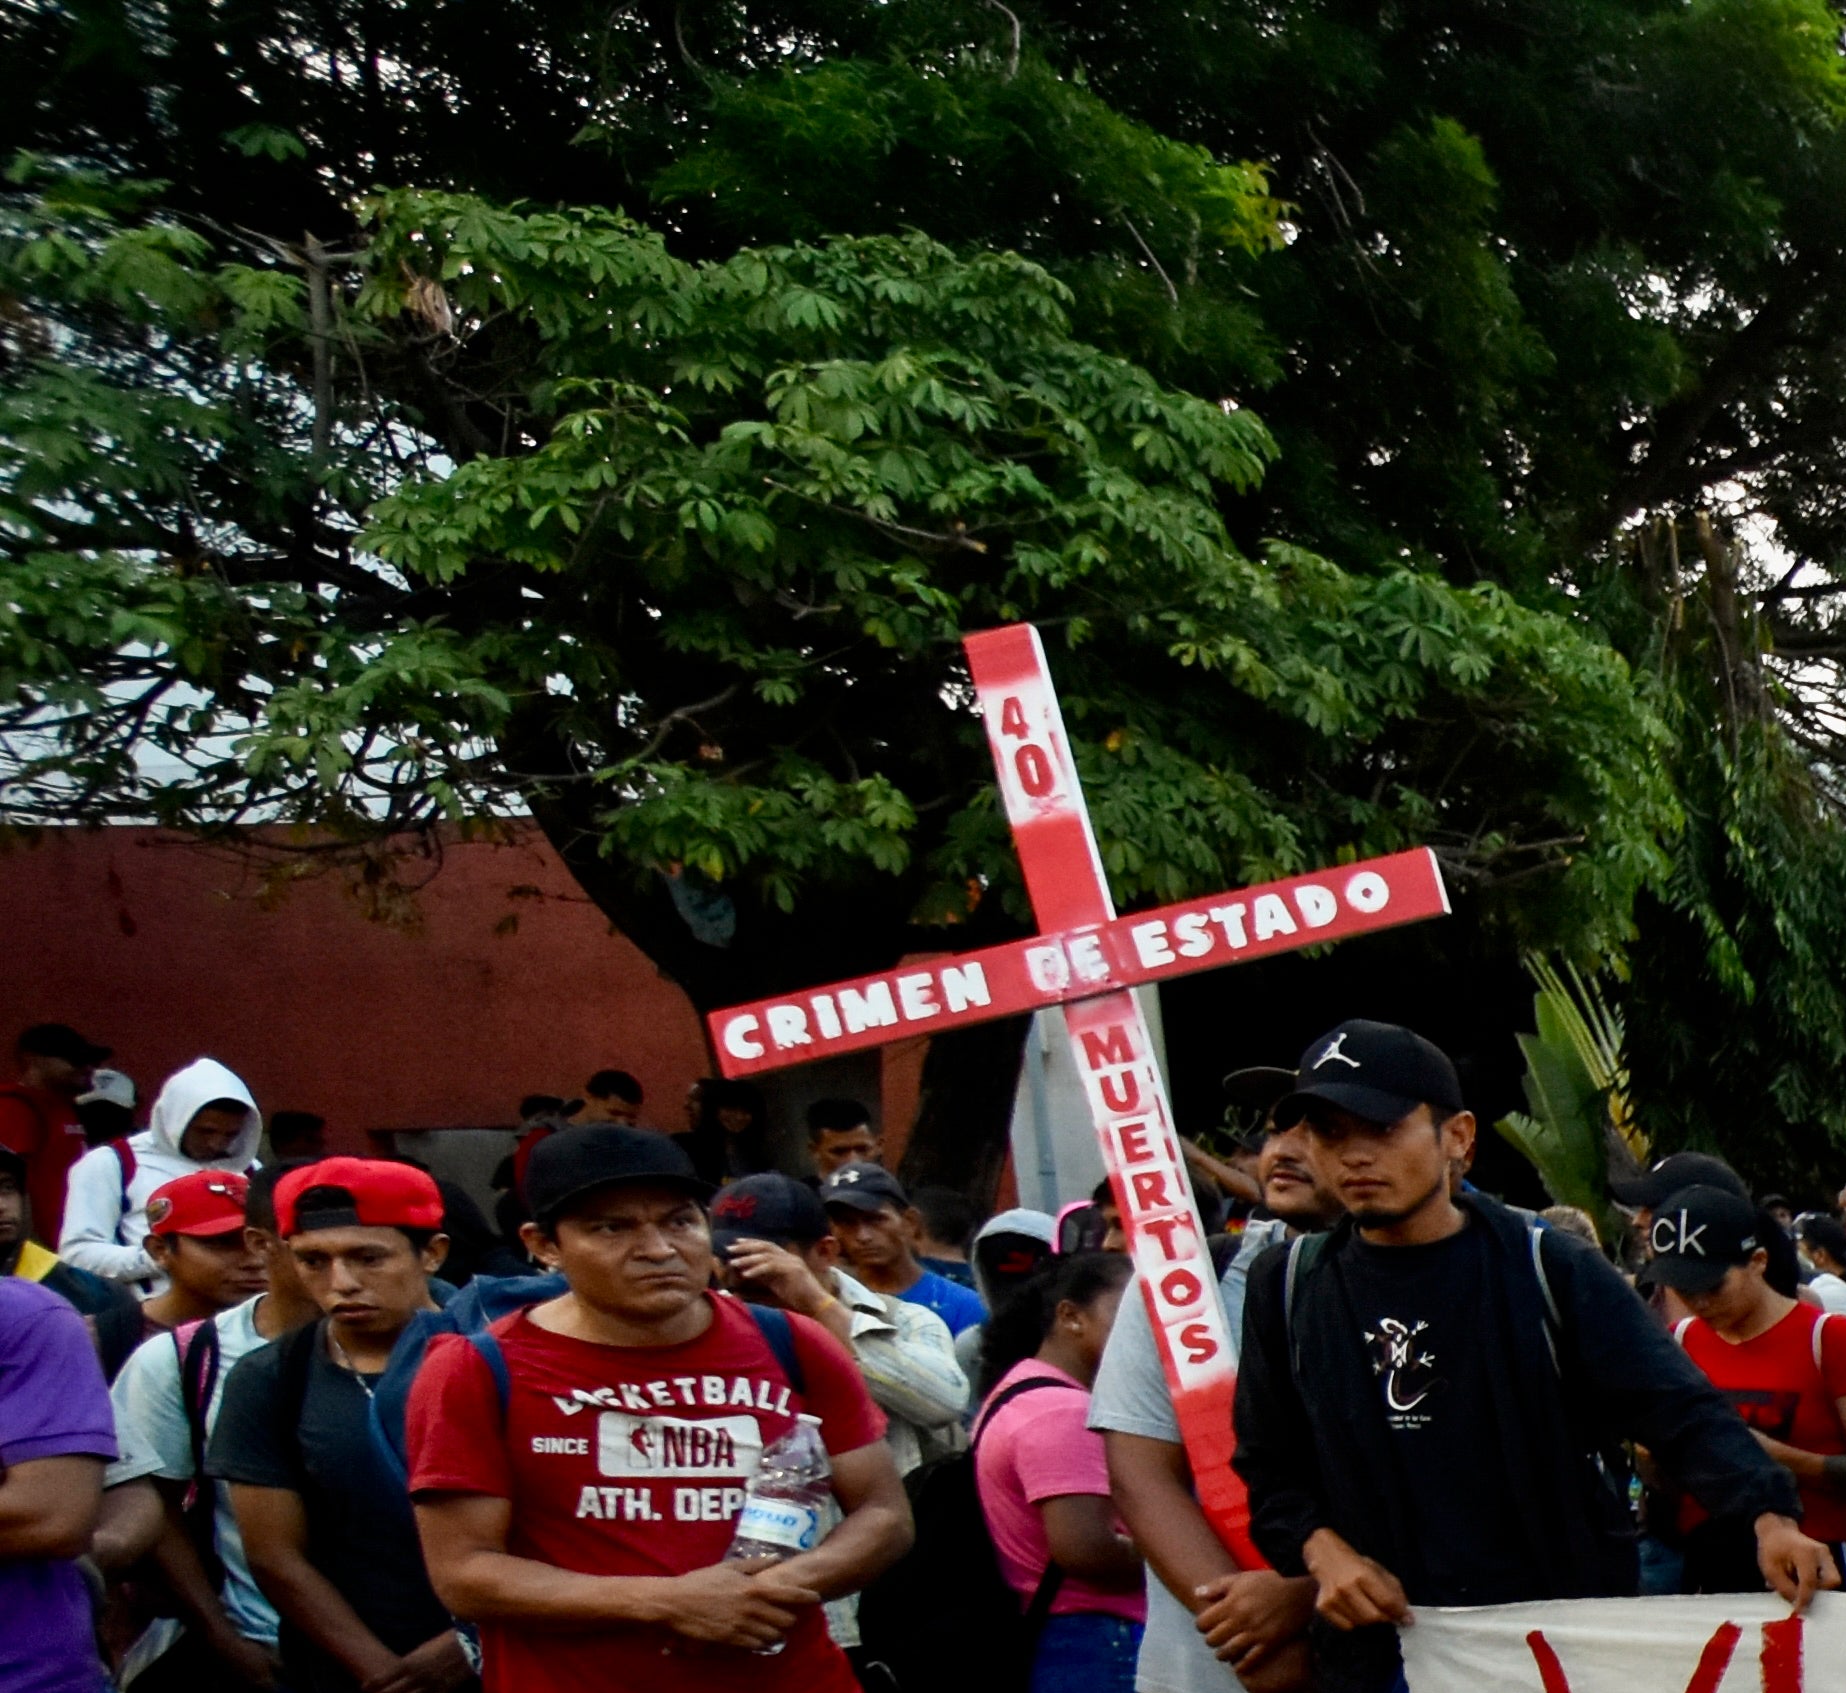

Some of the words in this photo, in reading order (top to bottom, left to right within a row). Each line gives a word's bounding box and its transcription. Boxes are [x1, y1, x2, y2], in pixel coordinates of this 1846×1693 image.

[1001, 696, 1055, 798] 40
[723, 962, 992, 1060] CRIMEN
[1024, 934, 1110, 991] DE
[1133, 870, 1390, 969] ESTADO
[1080, 1024, 1218, 1365] MUERTOS
[531, 1437, 589, 1455] SINCE
[663, 1426, 736, 1469] NBA
[576, 1486, 662, 1520] ATH.
[674, 1487, 748, 1521] DEP
